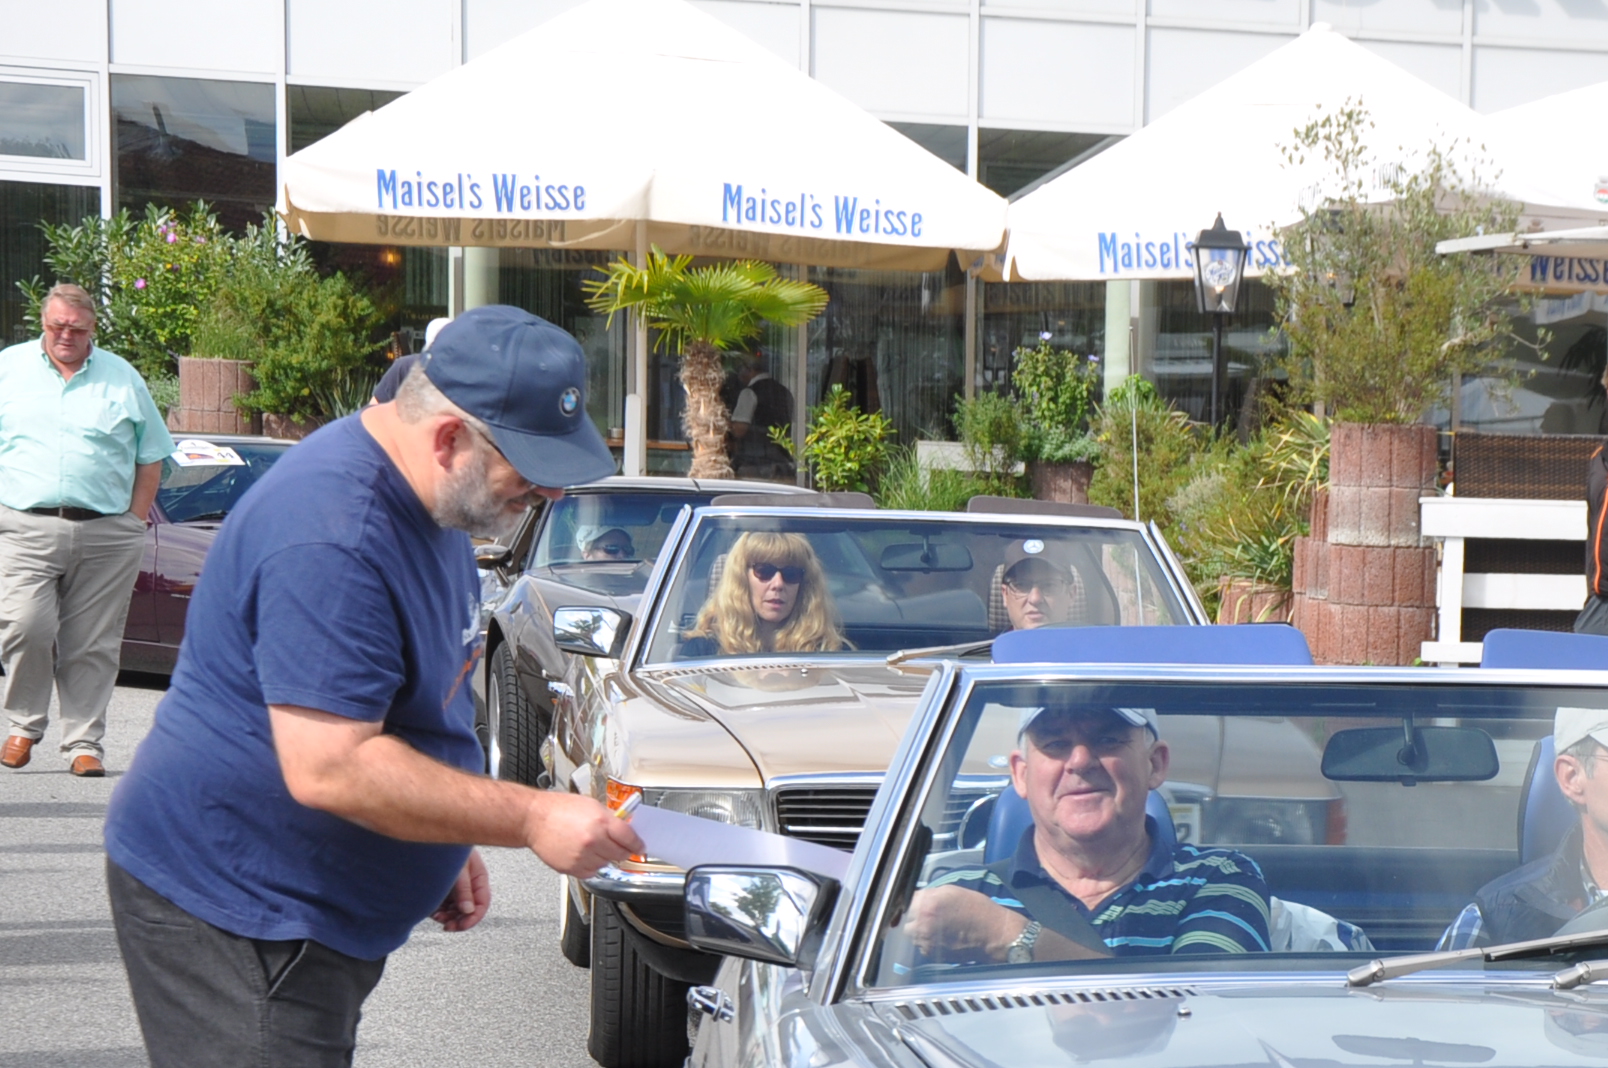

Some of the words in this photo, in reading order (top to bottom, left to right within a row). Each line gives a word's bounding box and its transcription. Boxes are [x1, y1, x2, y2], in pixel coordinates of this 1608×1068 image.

[376, 168, 483, 209] Maisel's
[492, 173, 586, 212] Weisse
[722, 182, 823, 228] Maisel's
[833, 194, 923, 237] Weisse
[1098, 232, 1195, 273] Maisel's
